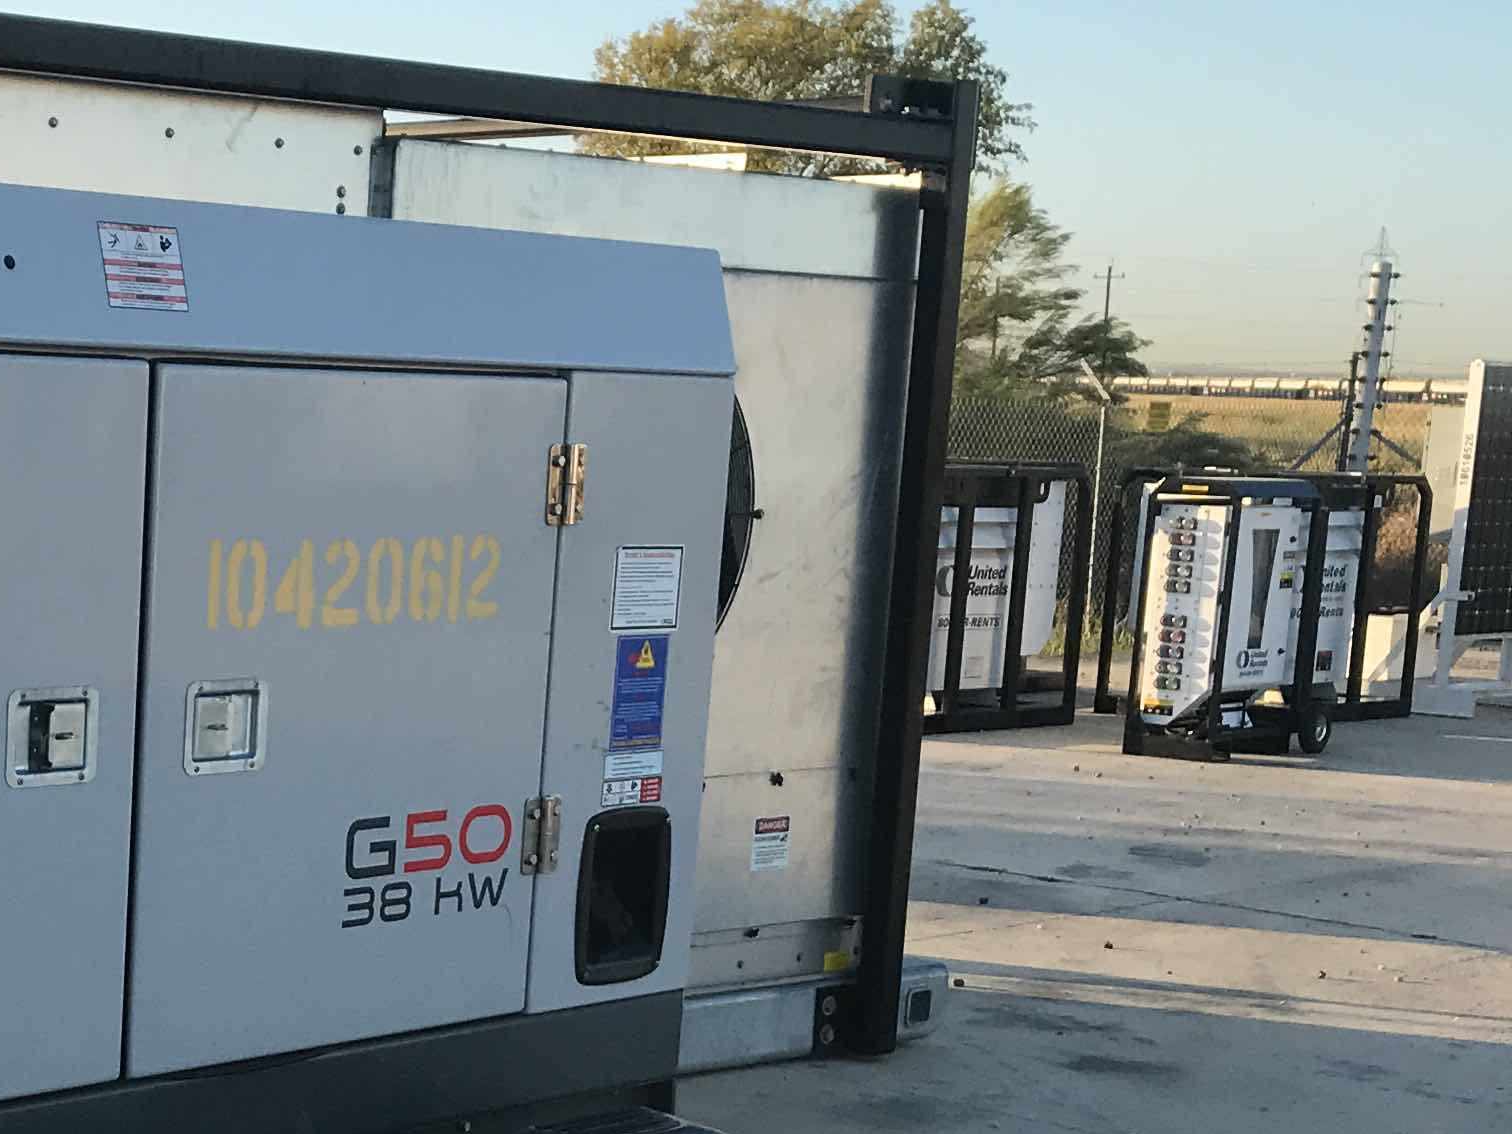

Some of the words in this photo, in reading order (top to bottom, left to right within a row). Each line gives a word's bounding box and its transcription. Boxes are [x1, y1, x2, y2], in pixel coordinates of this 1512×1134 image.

[207, 534, 502, 631] 10420612
[968, 563, 1007, 580] United
[968, 581, 1009, 596] Rentals
[345, 804, 512, 880] G50
[341, 881, 413, 928] 38
